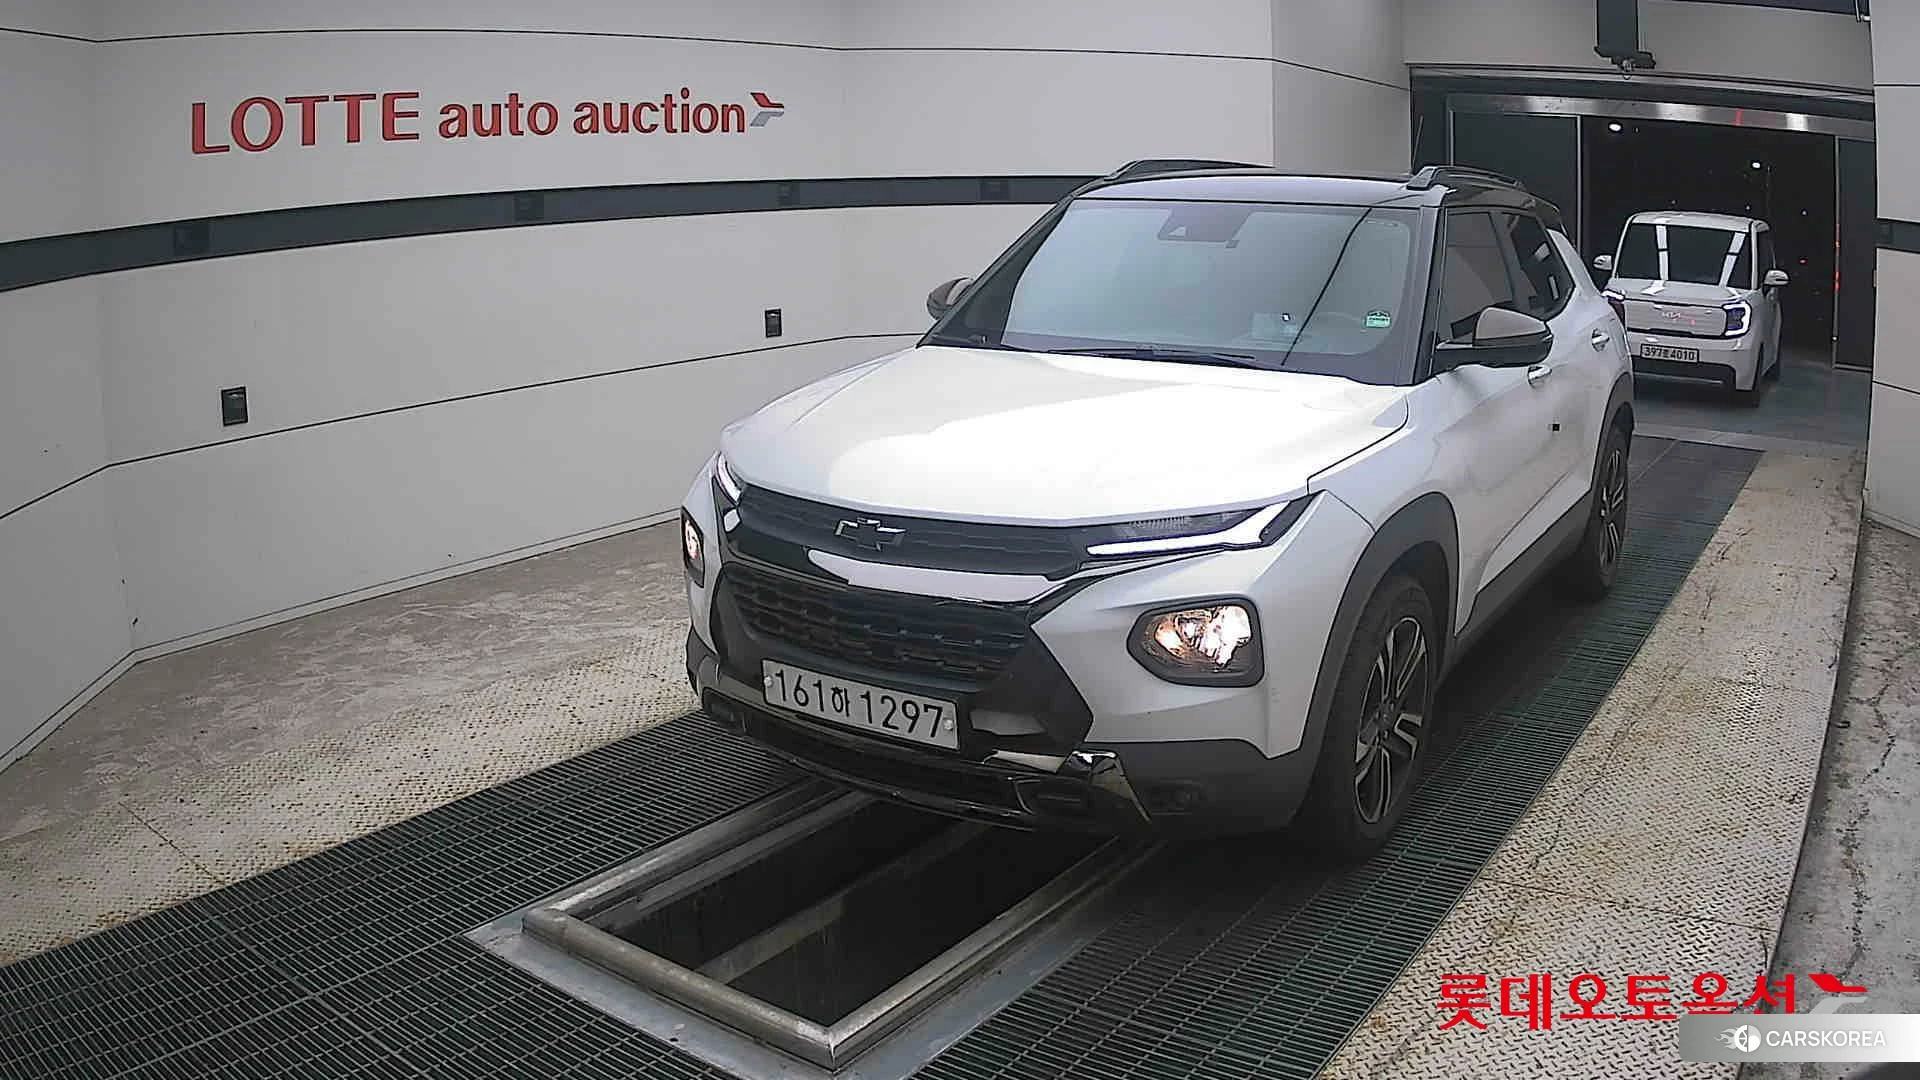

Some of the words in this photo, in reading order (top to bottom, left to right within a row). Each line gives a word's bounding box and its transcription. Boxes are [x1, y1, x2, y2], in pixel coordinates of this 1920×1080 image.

[191, 92, 419, 155] LOTTE
[438, 92, 559, 139] auto
[573, 87, 747, 136] auction
